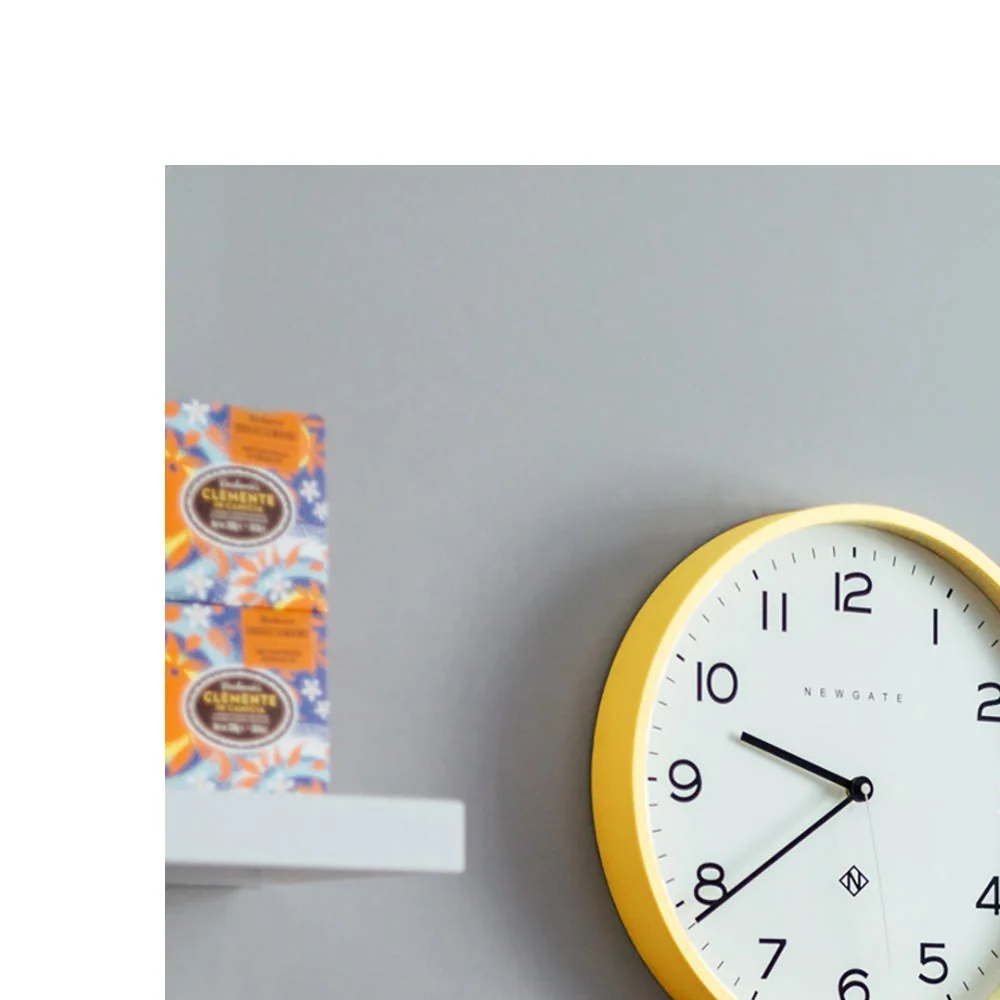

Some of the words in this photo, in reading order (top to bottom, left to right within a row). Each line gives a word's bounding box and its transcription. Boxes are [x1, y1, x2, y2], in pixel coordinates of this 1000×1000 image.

[201, 486, 276, 508] CLEMENTE
[762, 591, 787, 632] 11
[835, 572, 872, 614] 12
[932, 609, 938, 645] 1
[696, 662, 738, 704] 10
[804, 687, 904, 703] NEWGATE
[669, 759, 702, 802] 9
[694, 862, 728, 906] 8
[759, 939, 786, 979] 7
[919, 943, 948, 984] 5
